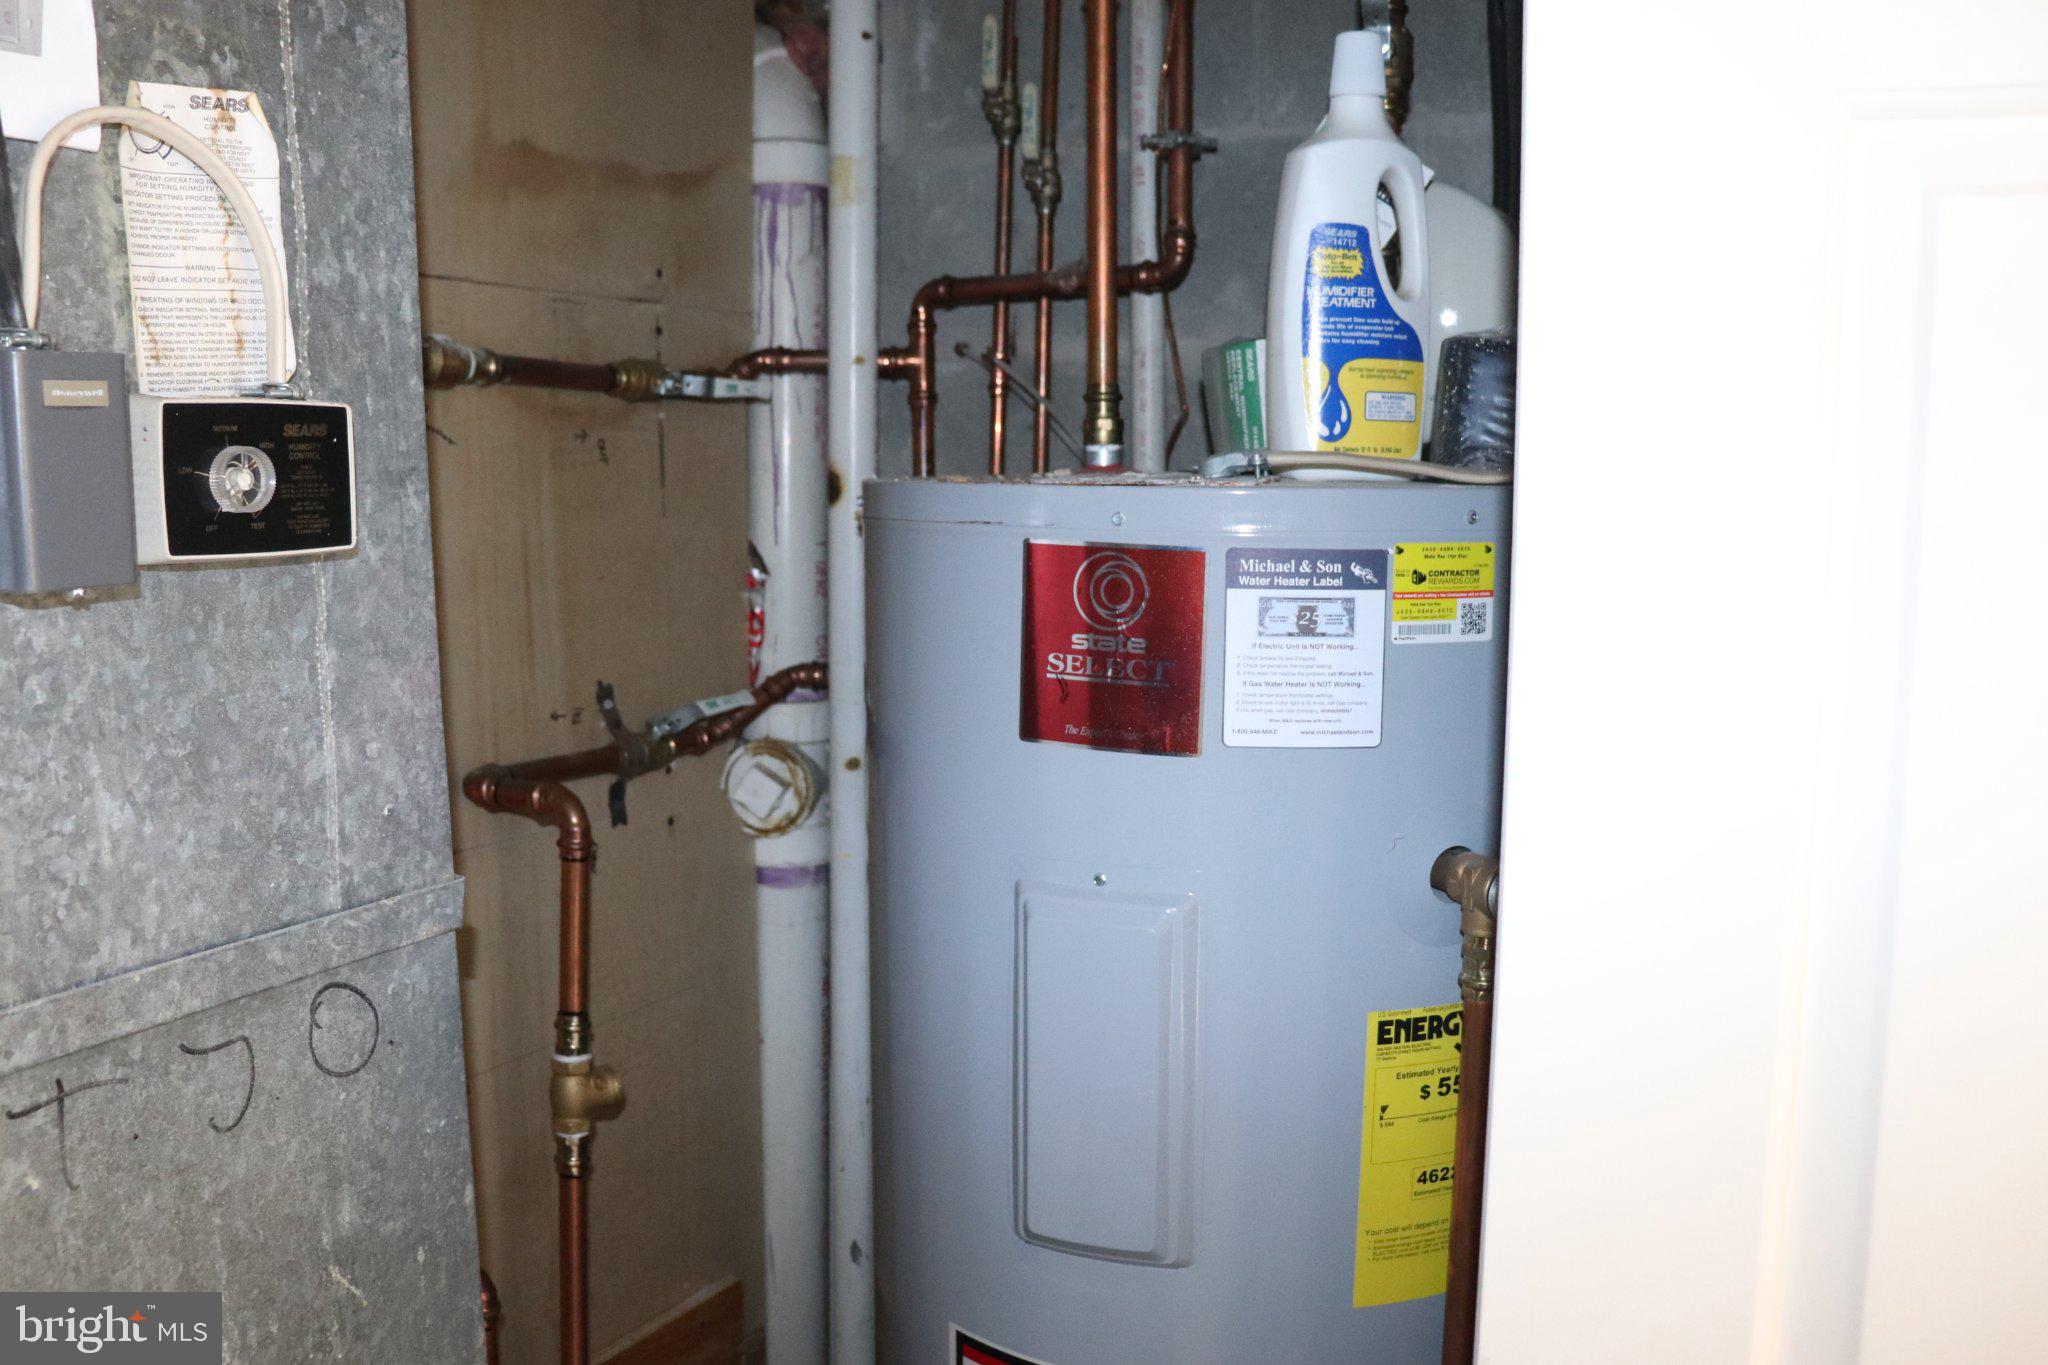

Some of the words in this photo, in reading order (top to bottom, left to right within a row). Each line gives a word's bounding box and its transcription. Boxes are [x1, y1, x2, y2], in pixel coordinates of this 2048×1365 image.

[189, 95, 249, 113] SEARS
[1307, 297, 1376, 308] TEATMENT
[282, 423, 328, 437] SEARS
[1240, 559, 1295, 573] Michael
[1299, 560, 1312, 573] &
[1317, 559, 1342, 573] Son
[1428, 569, 1479, 577] CONTRACTOR
[1239, 576, 1271, 586] Water
[1274, 576, 1310, 586] Heater
[1313, 576, 1342, 586] Label
[1428, 576, 1479, 585] REWARDS.COM
[1071, 633, 1147, 654] state
[1046, 652, 1175, 681] SELECT
[1064, 724, 1079, 735] The
[1377, 1010, 1463, 1045] ENERG
[1396, 1068, 1435, 1080] Estimated
[1436, 1065, 1459, 1074] Yearly
[1420, 1084, 1431, 1100] $
[1365, 1229, 1383, 1237] Your
[1384, 1226, 1399, 1234] cost
[1401, 1224, 1412, 1232] will
[1414, 1219, 1439, 1231] depend
[1440, 1217, 1449, 1225] on
